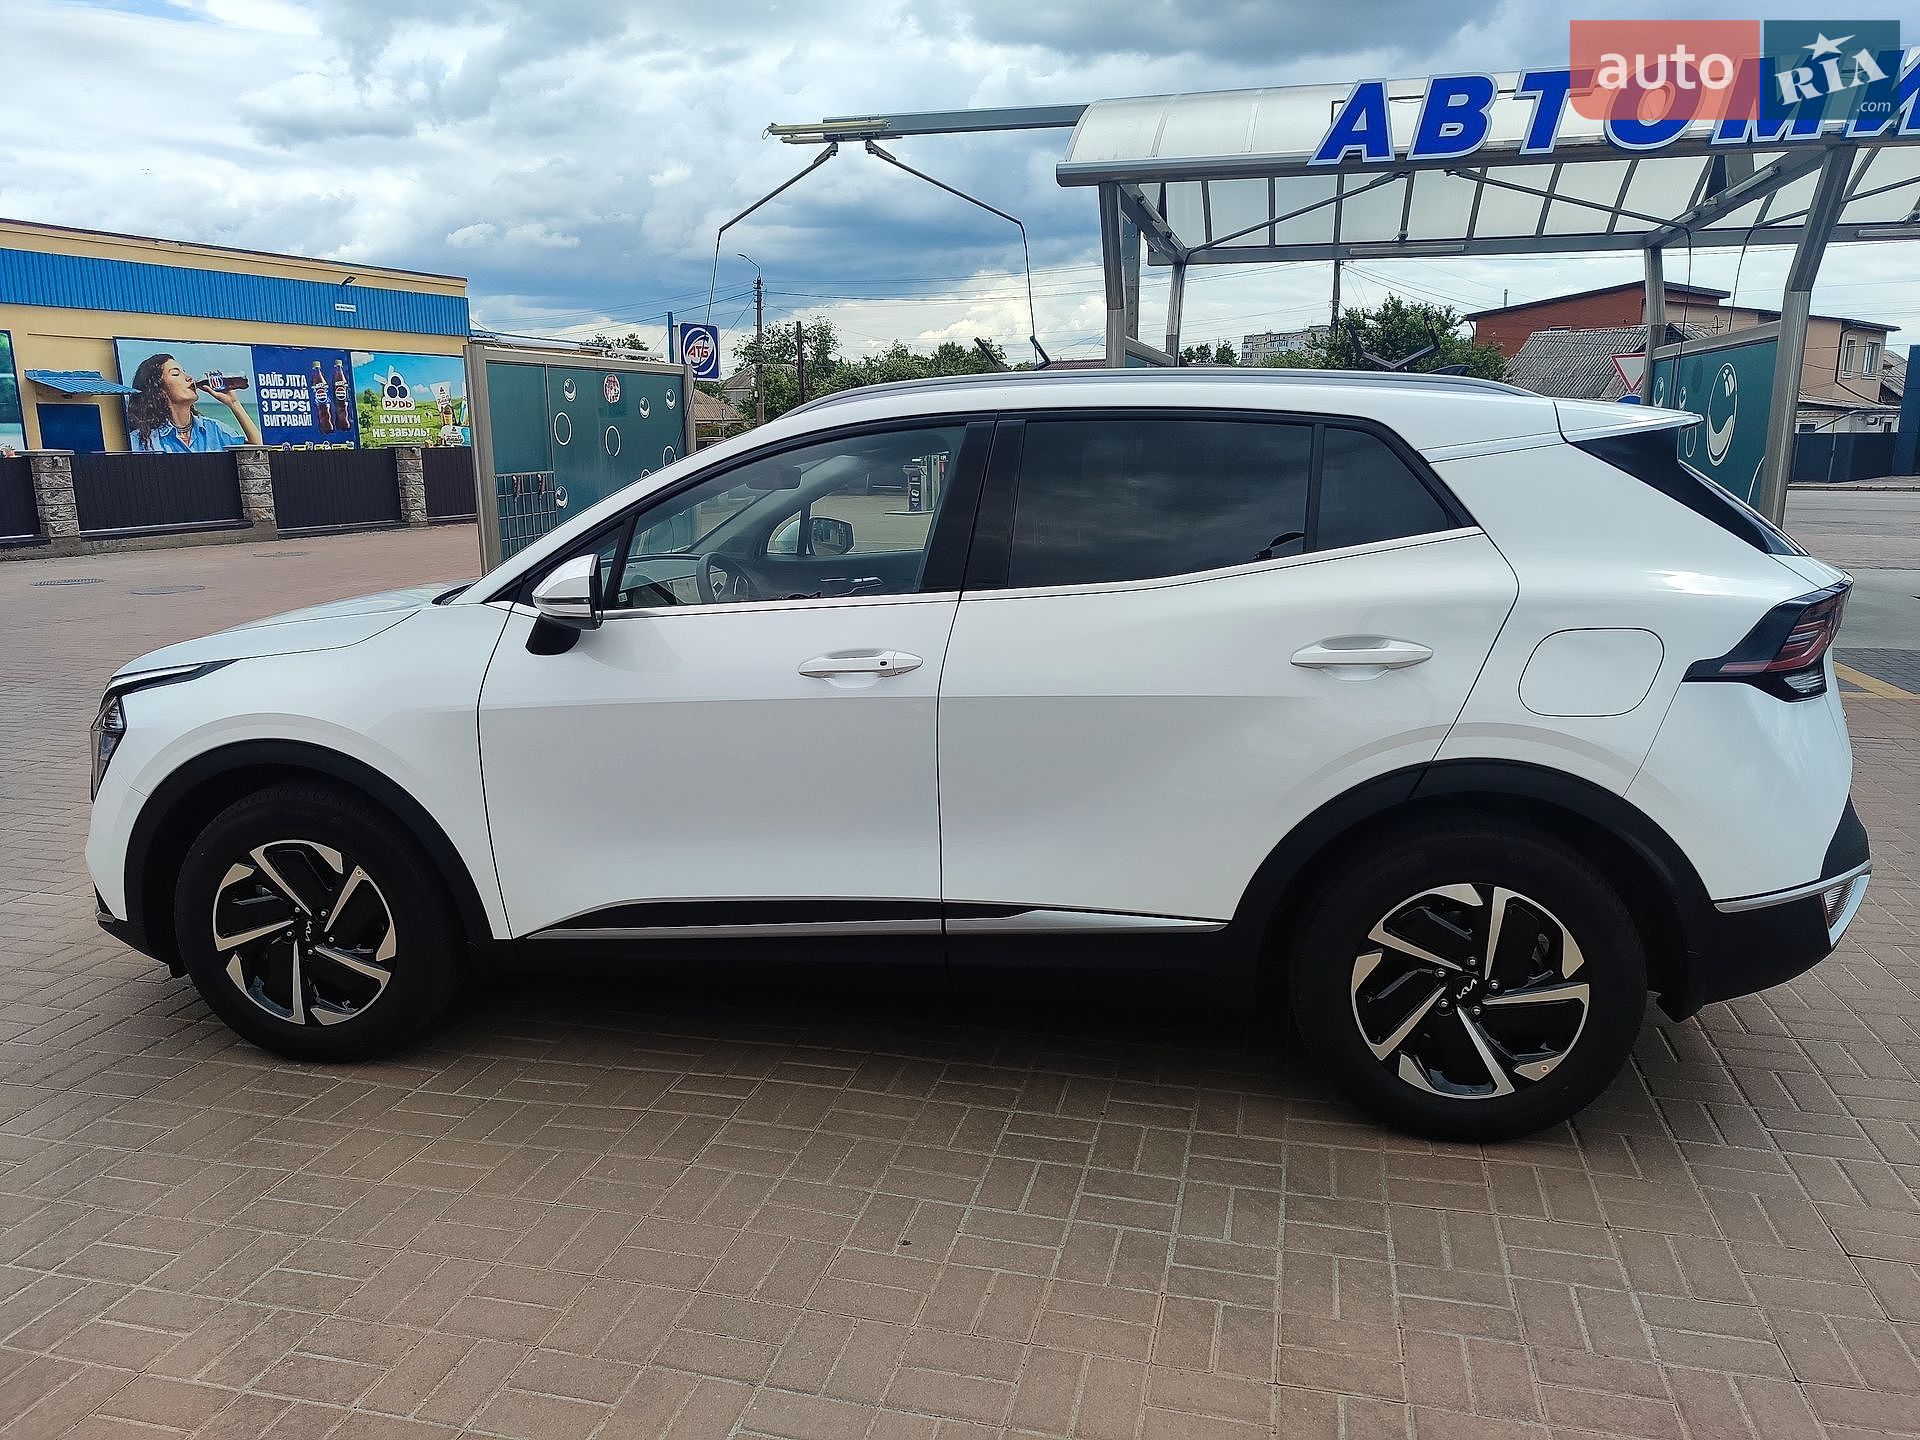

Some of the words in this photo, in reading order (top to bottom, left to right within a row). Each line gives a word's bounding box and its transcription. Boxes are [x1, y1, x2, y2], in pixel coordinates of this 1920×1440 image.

[258, 372, 284, 386] ВАЙБ
[286, 374, 307, 387] ЛІТА
[260, 388, 309, 400] ОБИРАЙ
[271, 401, 311, 412] PEPSI
[385, 400, 412, 408] РУДЬ
[263, 412, 312, 426] ВИГРАВАЙ!
[379, 415, 420, 424] КУПИТИ
[372, 428, 386, 437] НЕ
